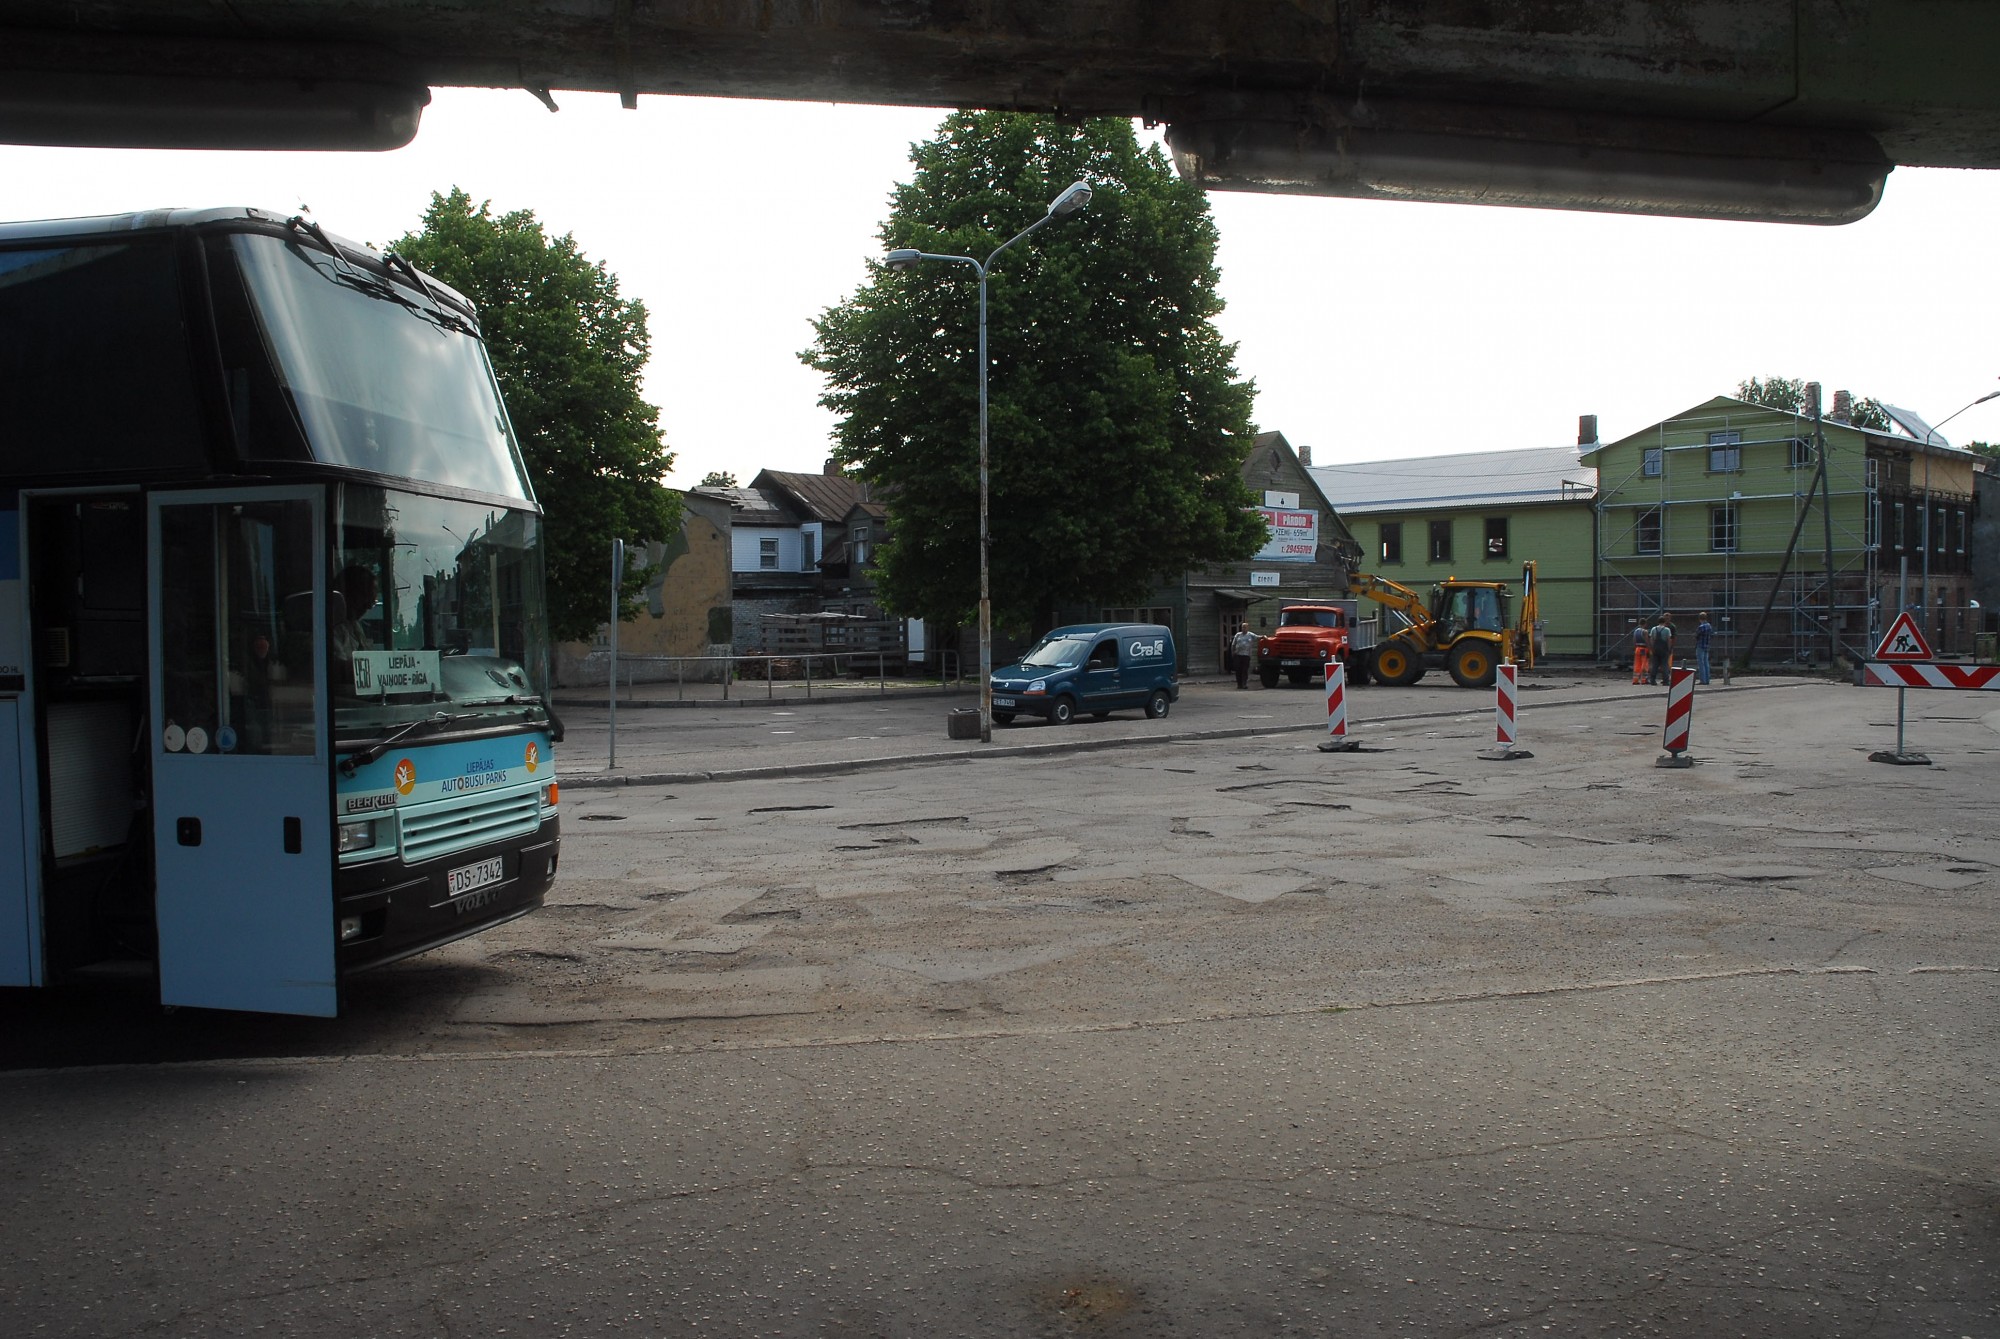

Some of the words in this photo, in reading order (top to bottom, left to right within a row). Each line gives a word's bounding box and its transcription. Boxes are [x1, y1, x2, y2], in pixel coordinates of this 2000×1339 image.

[1282, 514, 1307, 527] PĀRDOD
[466, 758, 494, 773] LIEPĀJAS
[441, 774, 484, 793] AUTOBUSU
[485, 770, 507, 786] PARKS
[456, 860, 501, 891] DS-7342
